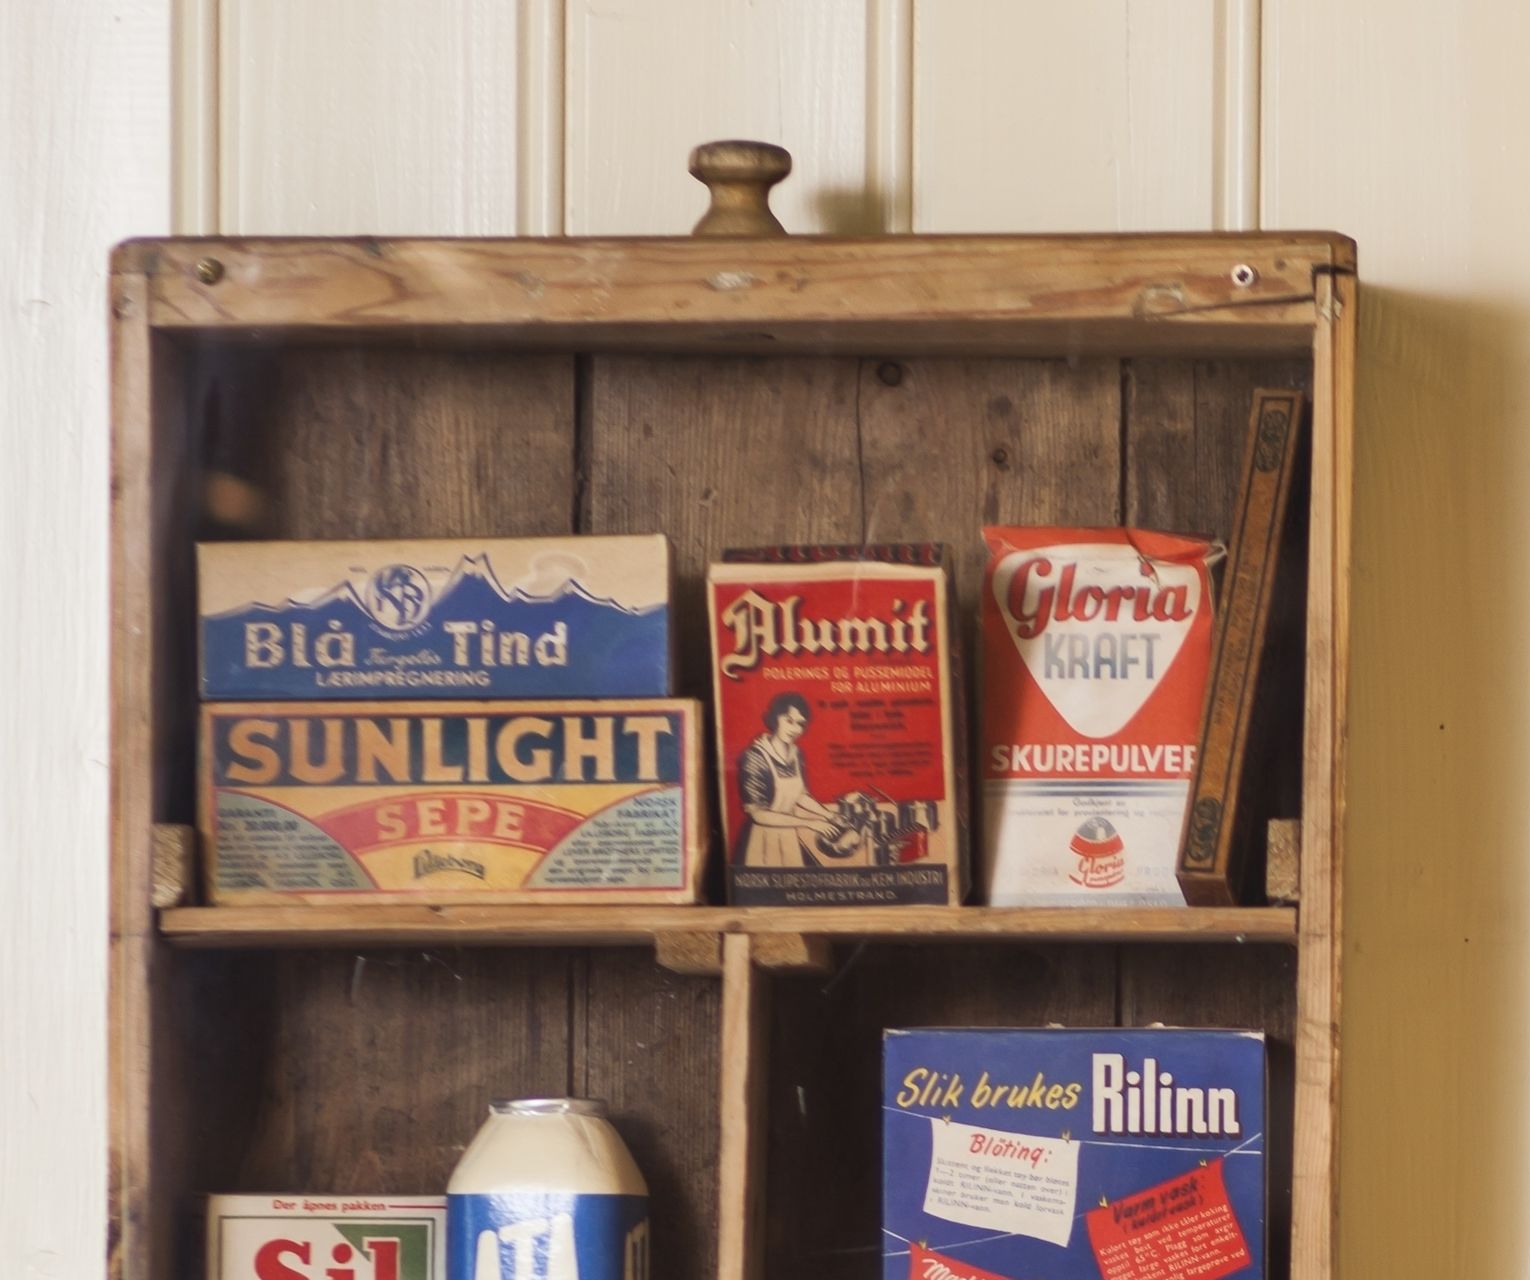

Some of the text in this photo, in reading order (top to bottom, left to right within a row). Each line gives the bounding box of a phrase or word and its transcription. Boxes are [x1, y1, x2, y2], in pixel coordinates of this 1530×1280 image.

[1005, 556, 1192, 639] Gloria
[243, 619, 355, 668] Blå
[443, 619, 568, 667] Tind
[721, 588, 931, 682] Alumit
[763, 665, 933, 680] POLERINGS OG PUSSEMIDDEL
[1043, 631, 1162, 681] KRAFT
[315, 670, 491, 688] LÆRIMPREGNERING
[831, 681, 932, 693] FOR ALUMINIUM
[224, 716, 674, 785] SUNLIGHT
[375, 797, 528, 842] SEPE
[896, 870, 944, 887] INDUSTRI
[1077, 854, 1126, 881] Gloria
[786, 890, 898, 902] HOLMESTRAND
[896, 1052, 1241, 1135] Slik brukes Rilinn
[272, 1199, 387, 1213] Der åpnes pakken
